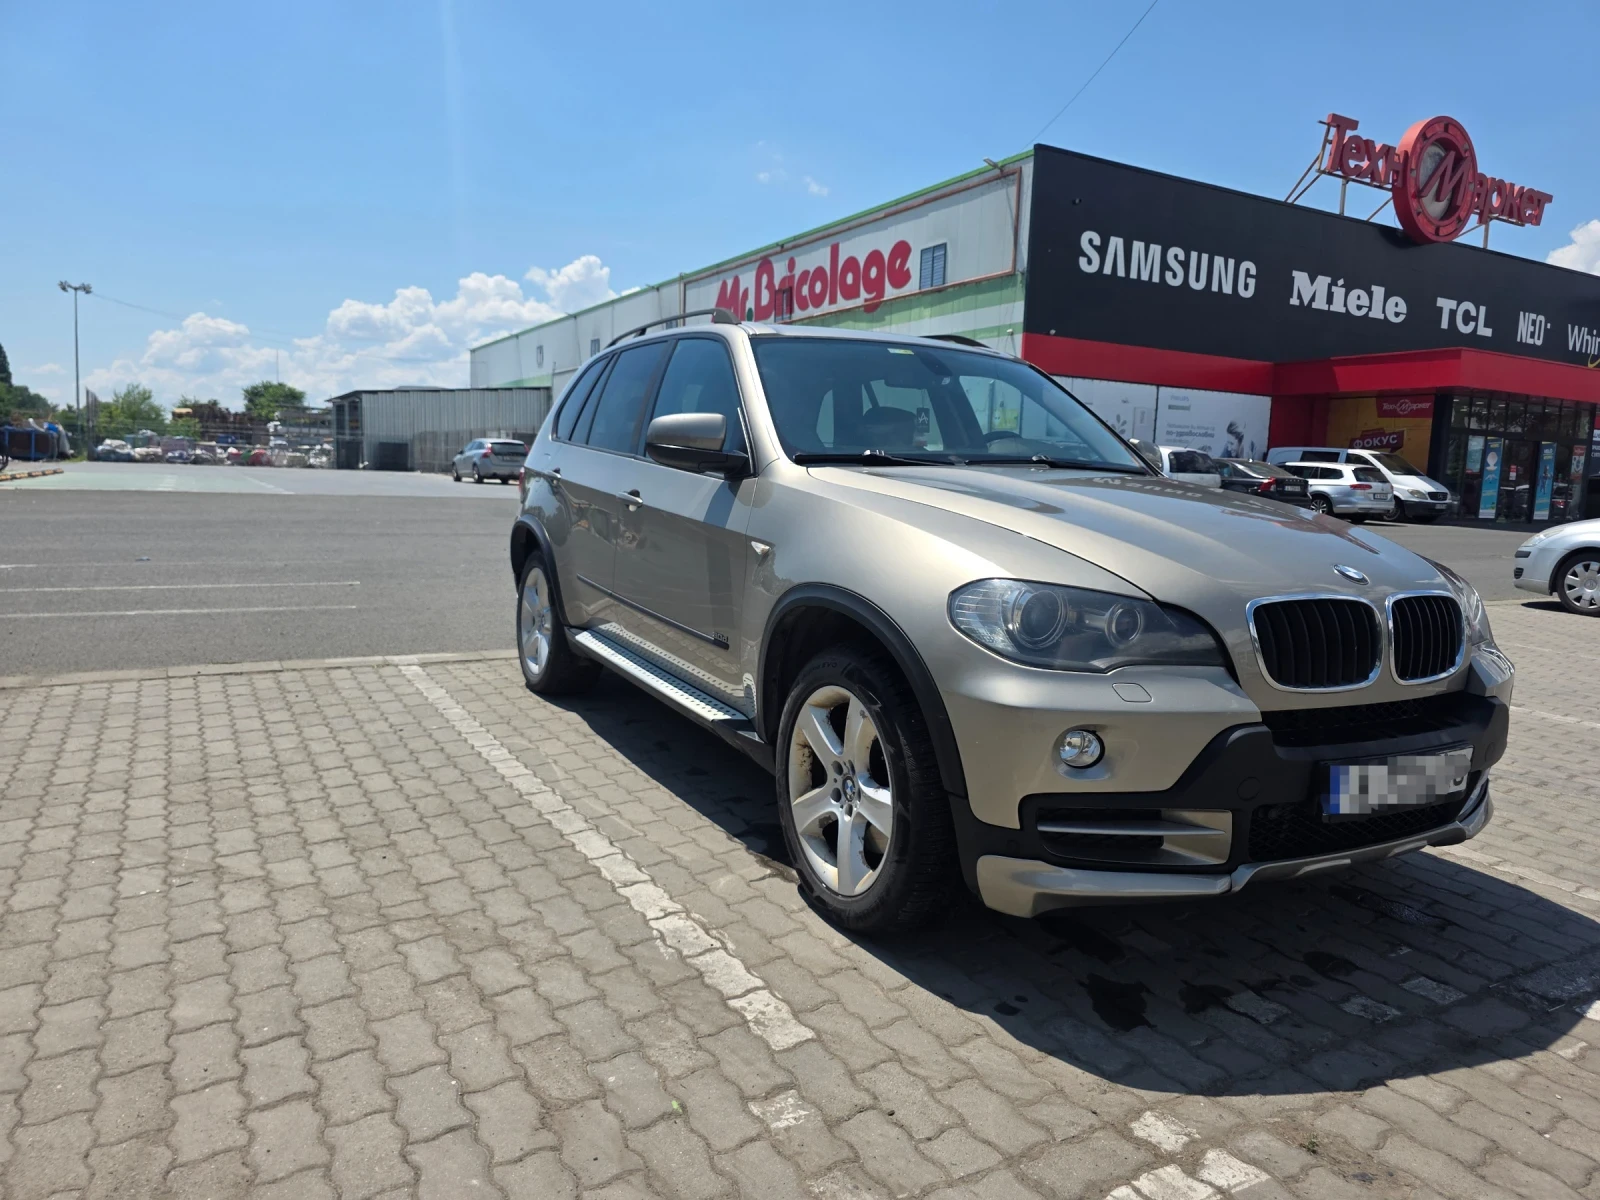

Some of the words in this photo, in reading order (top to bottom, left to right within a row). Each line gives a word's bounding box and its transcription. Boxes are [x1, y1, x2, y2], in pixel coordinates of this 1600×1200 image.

[1078, 230, 1257, 299] SAMSUNG
[1289, 269, 1408, 324] Miele
[1436, 296, 1493, 338] TCL
[1353, 434, 1398, 449] ФОКУС
